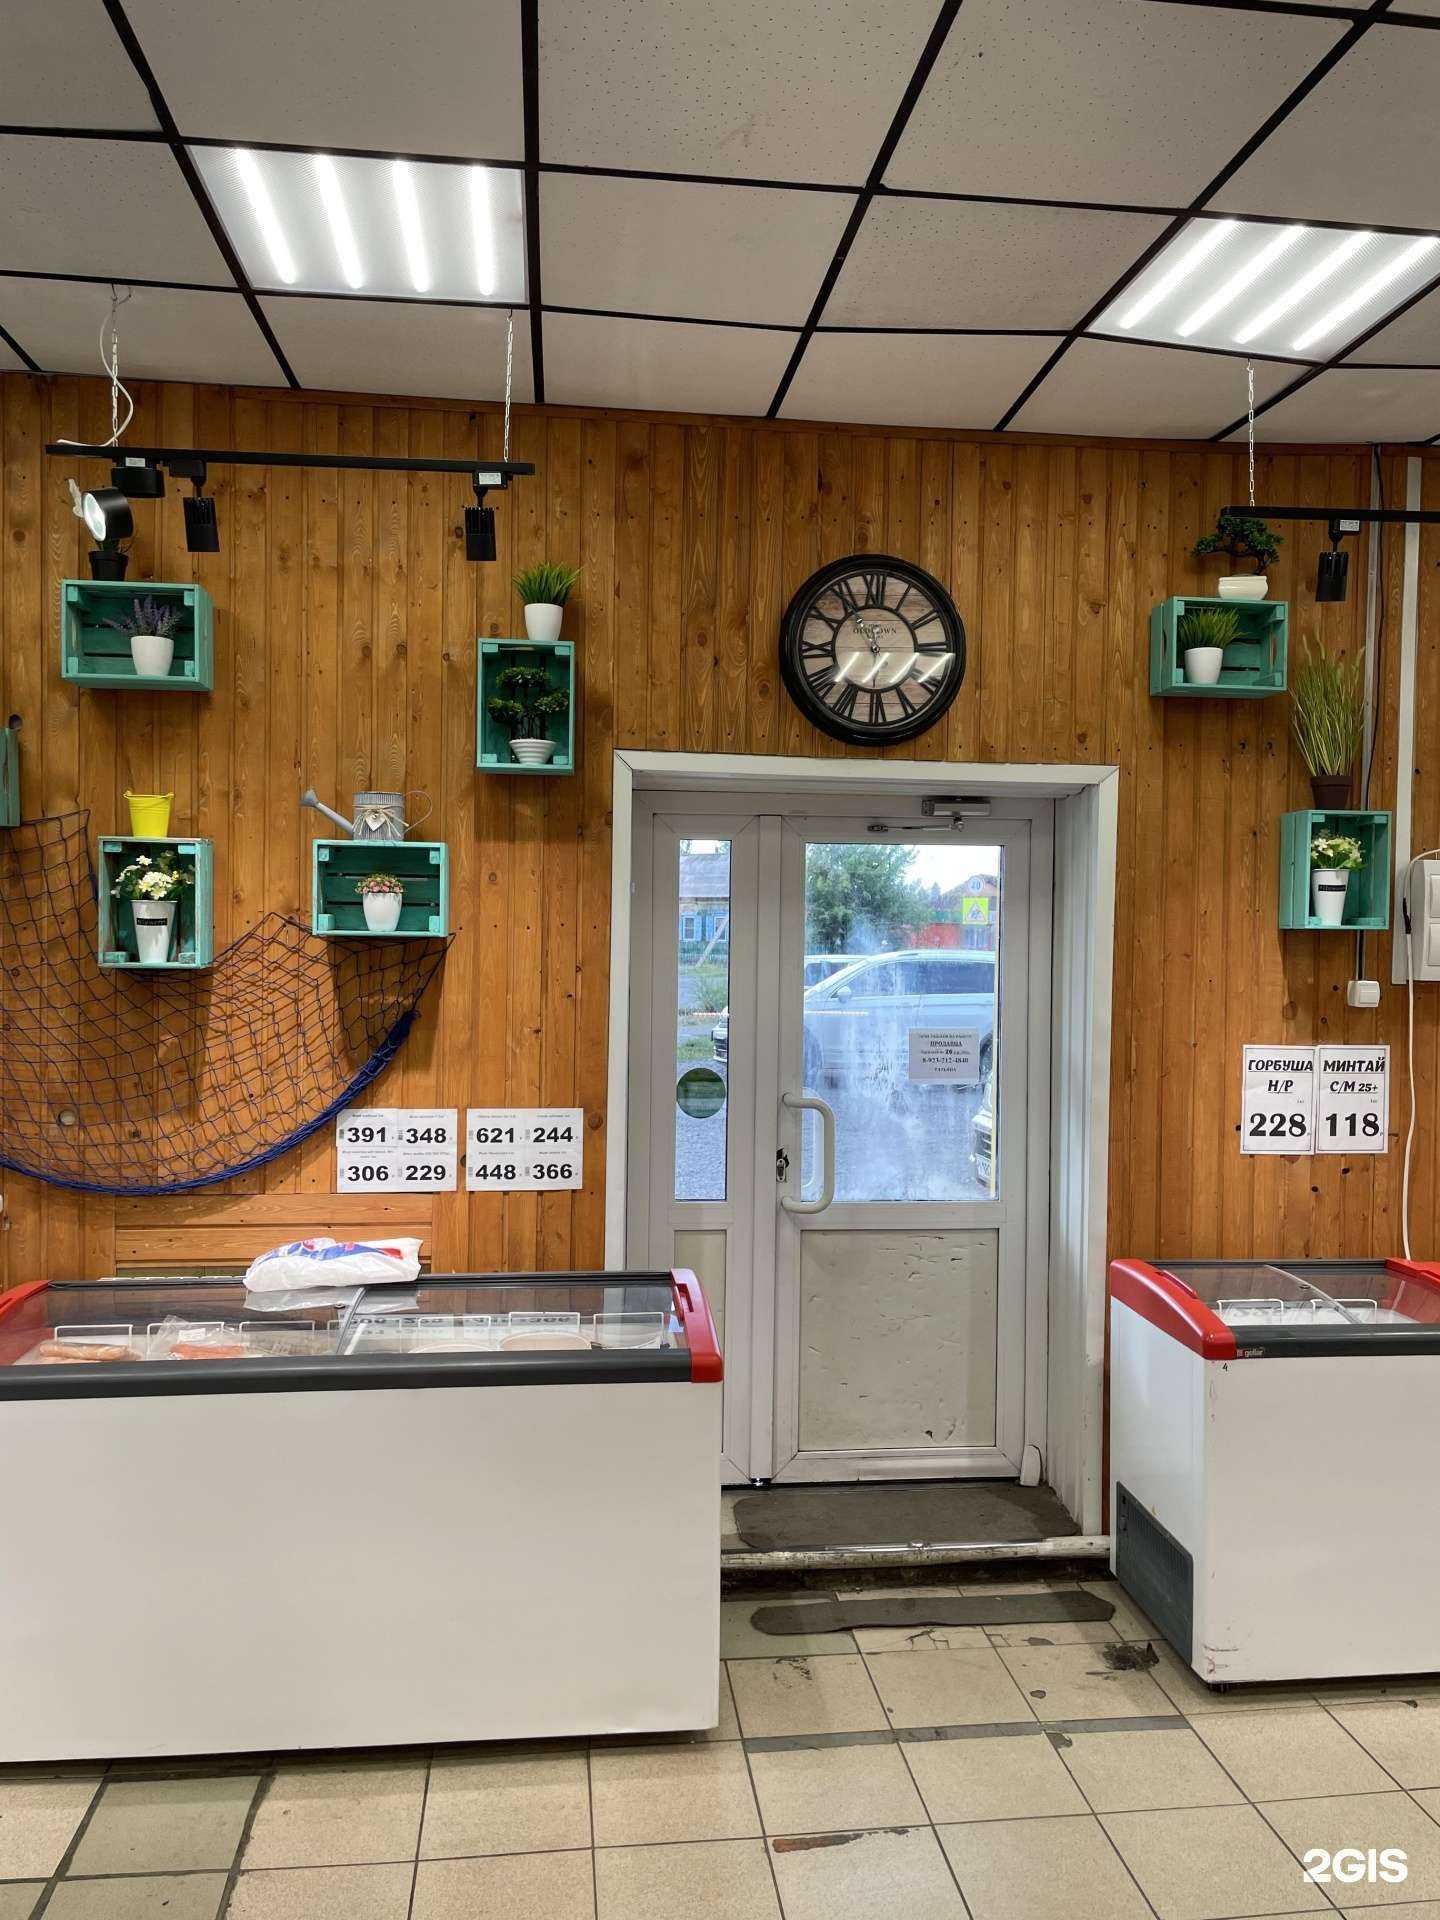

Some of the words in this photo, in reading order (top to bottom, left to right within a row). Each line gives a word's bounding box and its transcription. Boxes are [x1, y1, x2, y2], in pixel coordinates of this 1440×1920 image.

[1248, 1059, 1313, 1072] ГОРБУША
[1323, 1056, 1385, 1072] МИНТАЙ
[1267, 1080, 1294, 1094] Н/Р
[1329, 1081, 1355, 1094] С/М
[1358, 1083, 1378, 1092] 25+
[1249, 1113, 1307, 1137] 228
[1325, 1112, 1380, 1137] 118
[347, 1127, 386, 1143] 391
[405, 1128, 447, 1144] 348
[476, 1127, 514, 1143] 621
[533, 1127, 574, 1143] 244
[347, 1165, 389, 1181] 306
[405, 1165, 446, 1181] 229
[475, 1164, 516, 1180] 448
[532, 1164, 573, 1179] 366
[1222, 1362, 1229, 1372] 4
